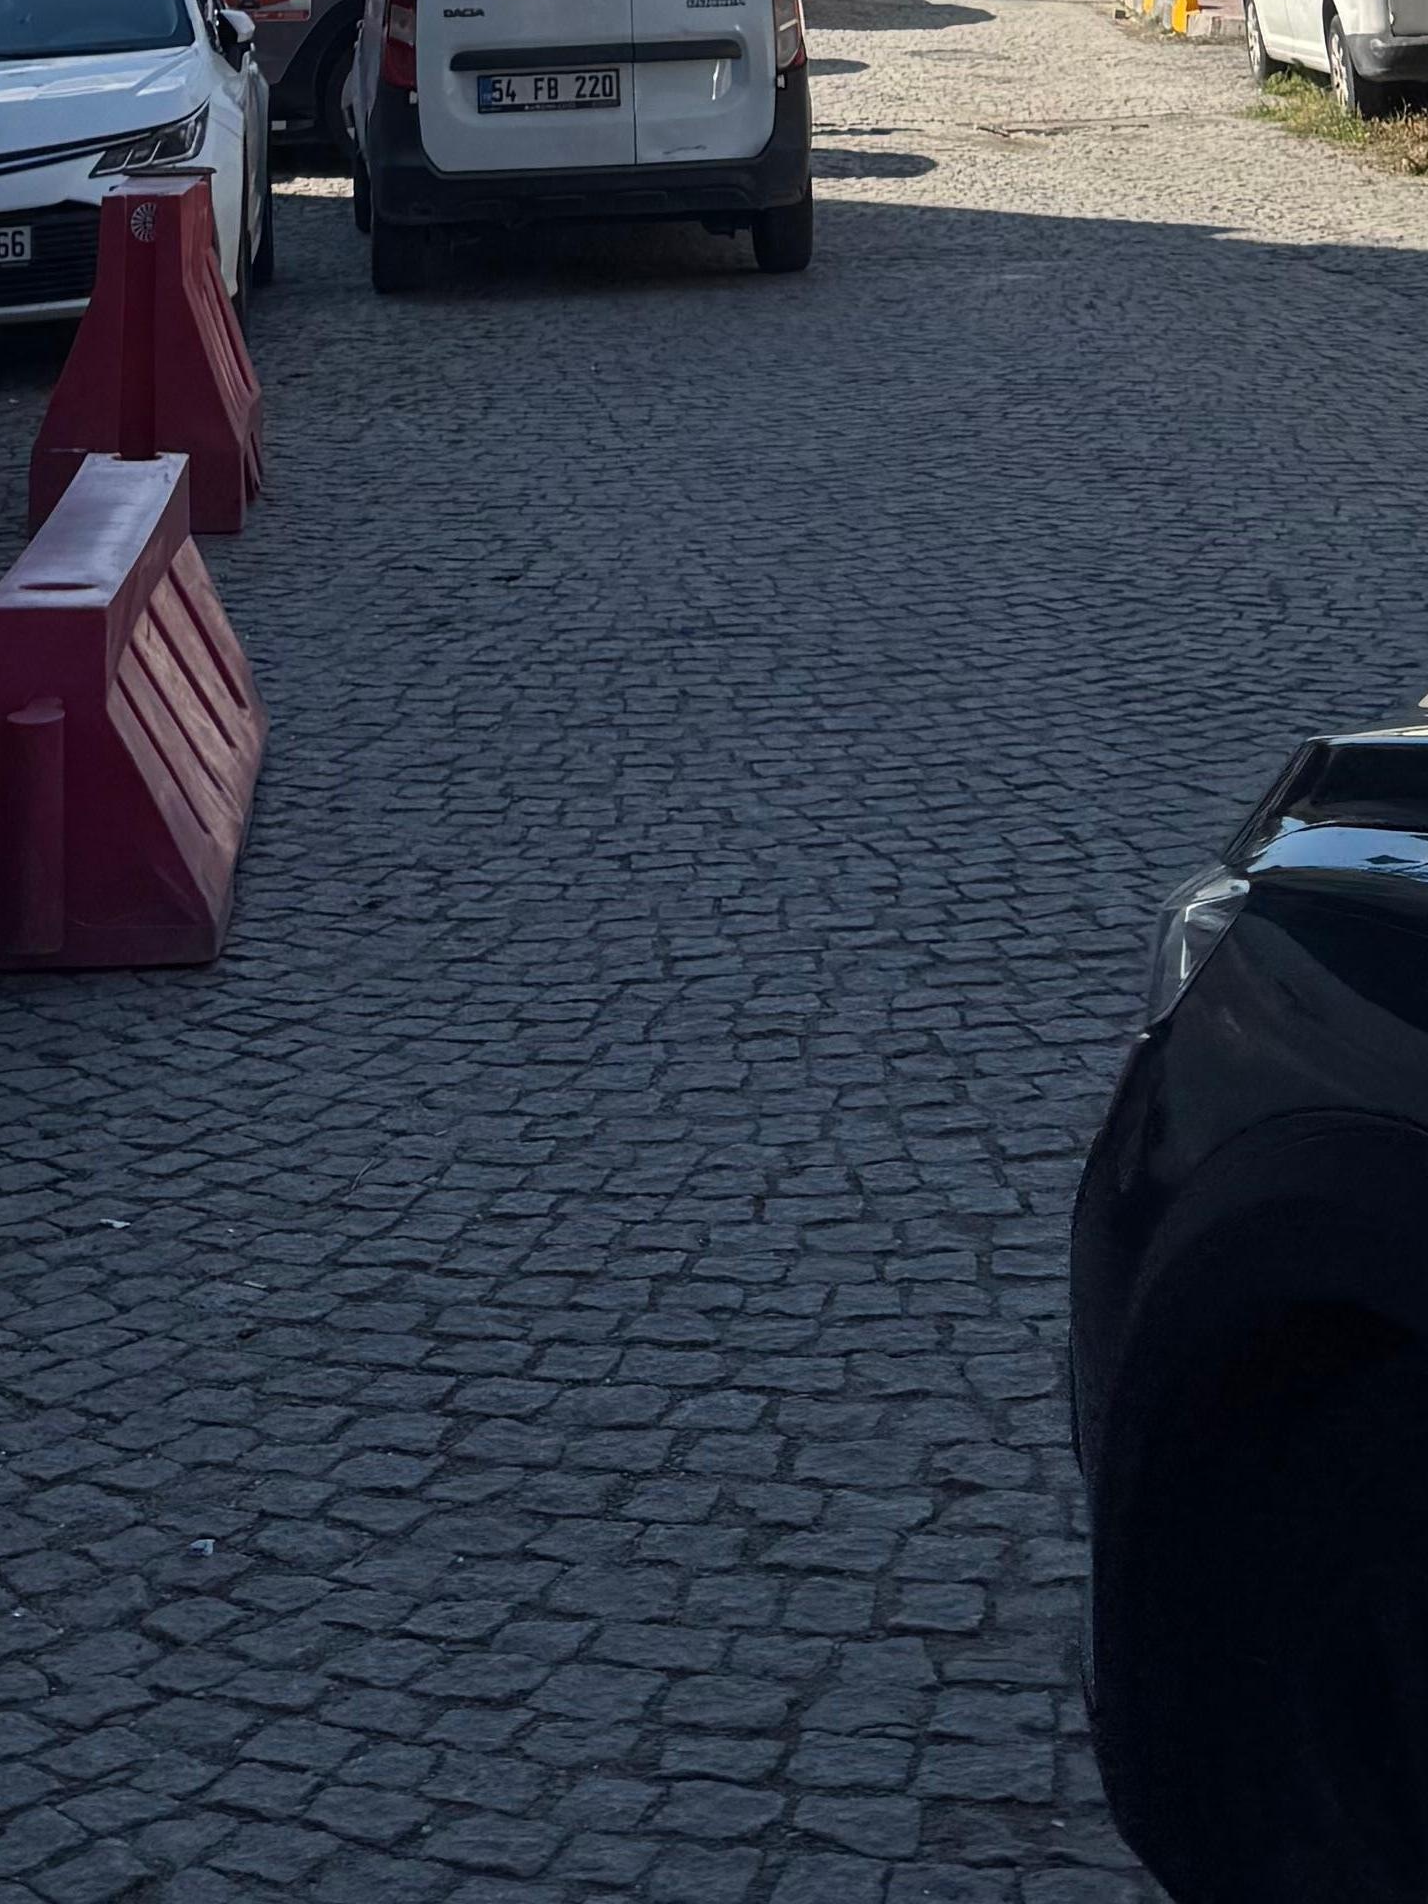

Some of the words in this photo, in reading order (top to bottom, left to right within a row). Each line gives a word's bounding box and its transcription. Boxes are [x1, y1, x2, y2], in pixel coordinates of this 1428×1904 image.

[491, 78, 516, 102] 54
[534, 77, 559, 100] FB
[575, 74, 613, 99] 220
